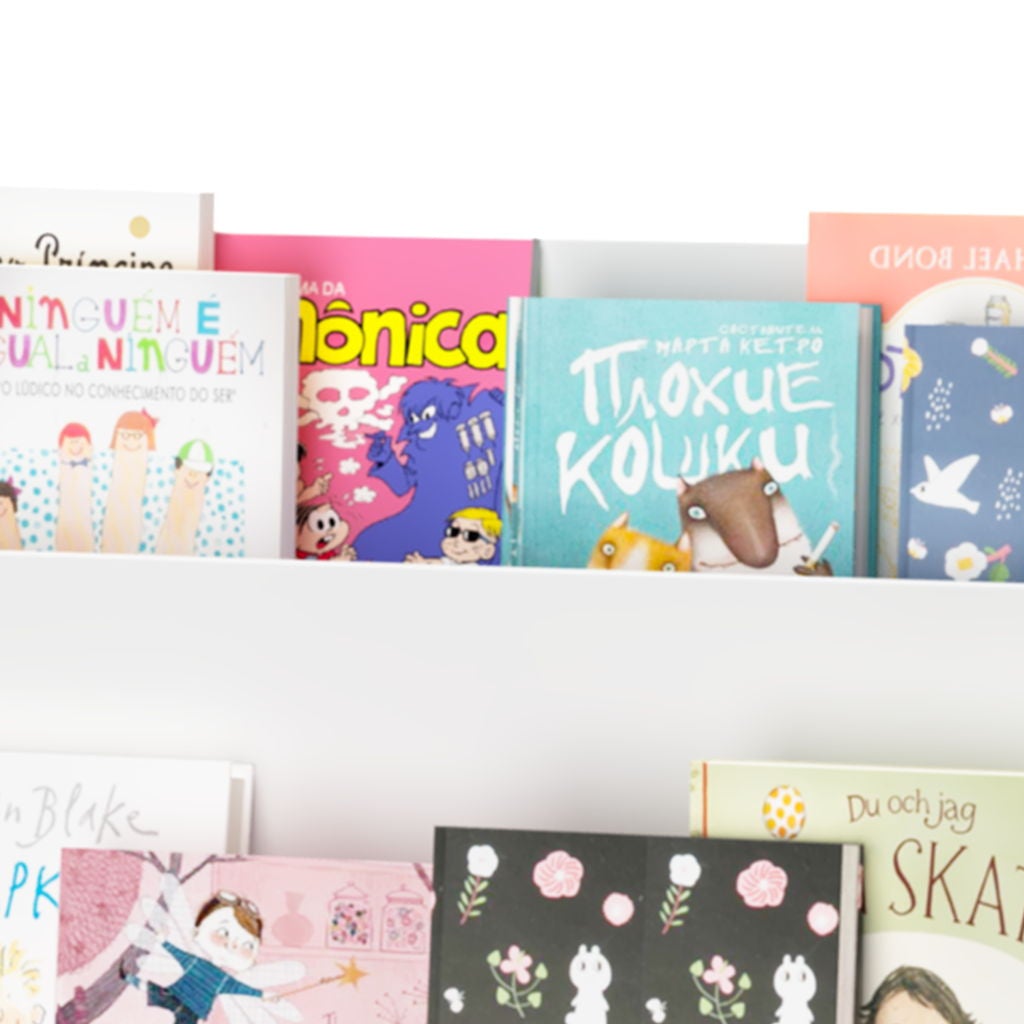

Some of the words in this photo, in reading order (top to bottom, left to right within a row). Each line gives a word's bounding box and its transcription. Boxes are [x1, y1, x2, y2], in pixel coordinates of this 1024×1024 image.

[322, 281, 346, 296] DA
[197, 293, 220, 335] É
[739, 337, 824, 355] КЕТРО
[15, 380, 61, 398] LÚDICO
[65, 384, 85, 399] NO
[88, 383, 186, 402] CONHECIMENTO
[189, 386, 210, 402] DO
[15, 783, 158, 848] Blake
[848, 795, 879, 822] Du
[888, 789, 930, 814] och
[923, 792, 976, 835] jag
